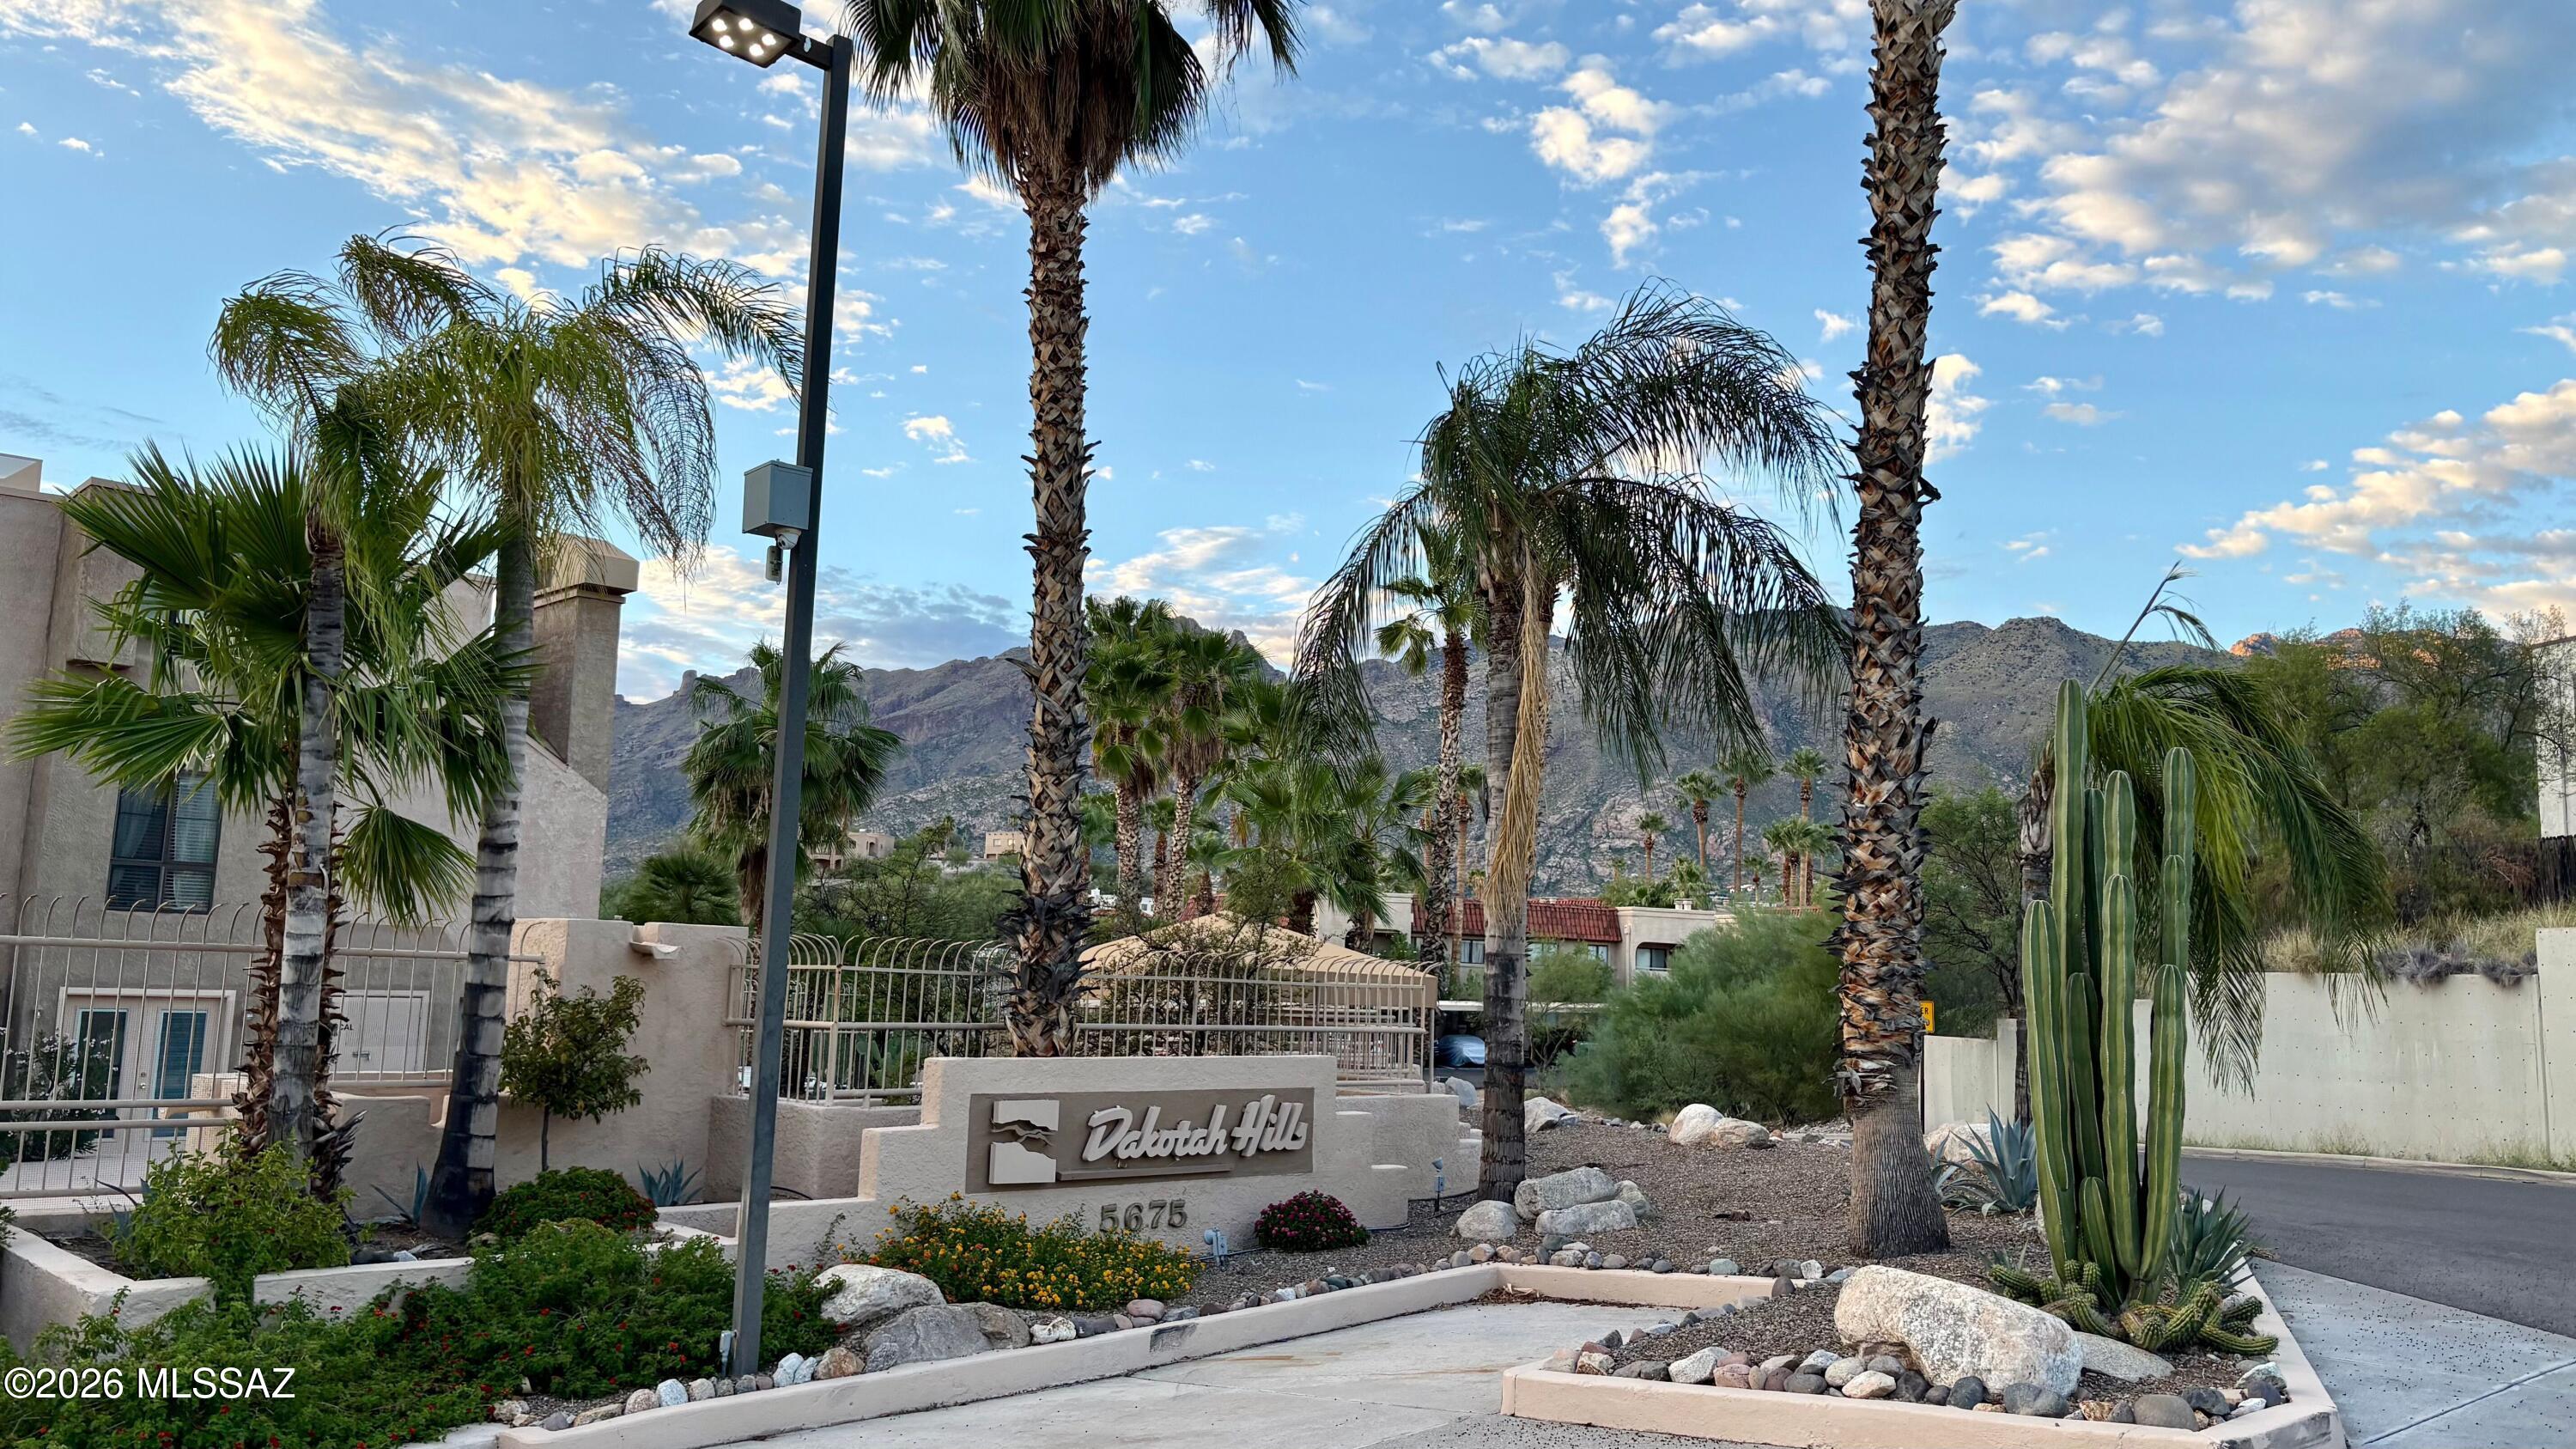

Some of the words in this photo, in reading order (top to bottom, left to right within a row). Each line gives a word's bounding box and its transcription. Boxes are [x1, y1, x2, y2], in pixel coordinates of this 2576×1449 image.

[1082, 1104, 1227, 1162] Dakotah
[1230, 1094, 1309, 1157] Hills
[1099, 1199, 1188, 1233] 5675
